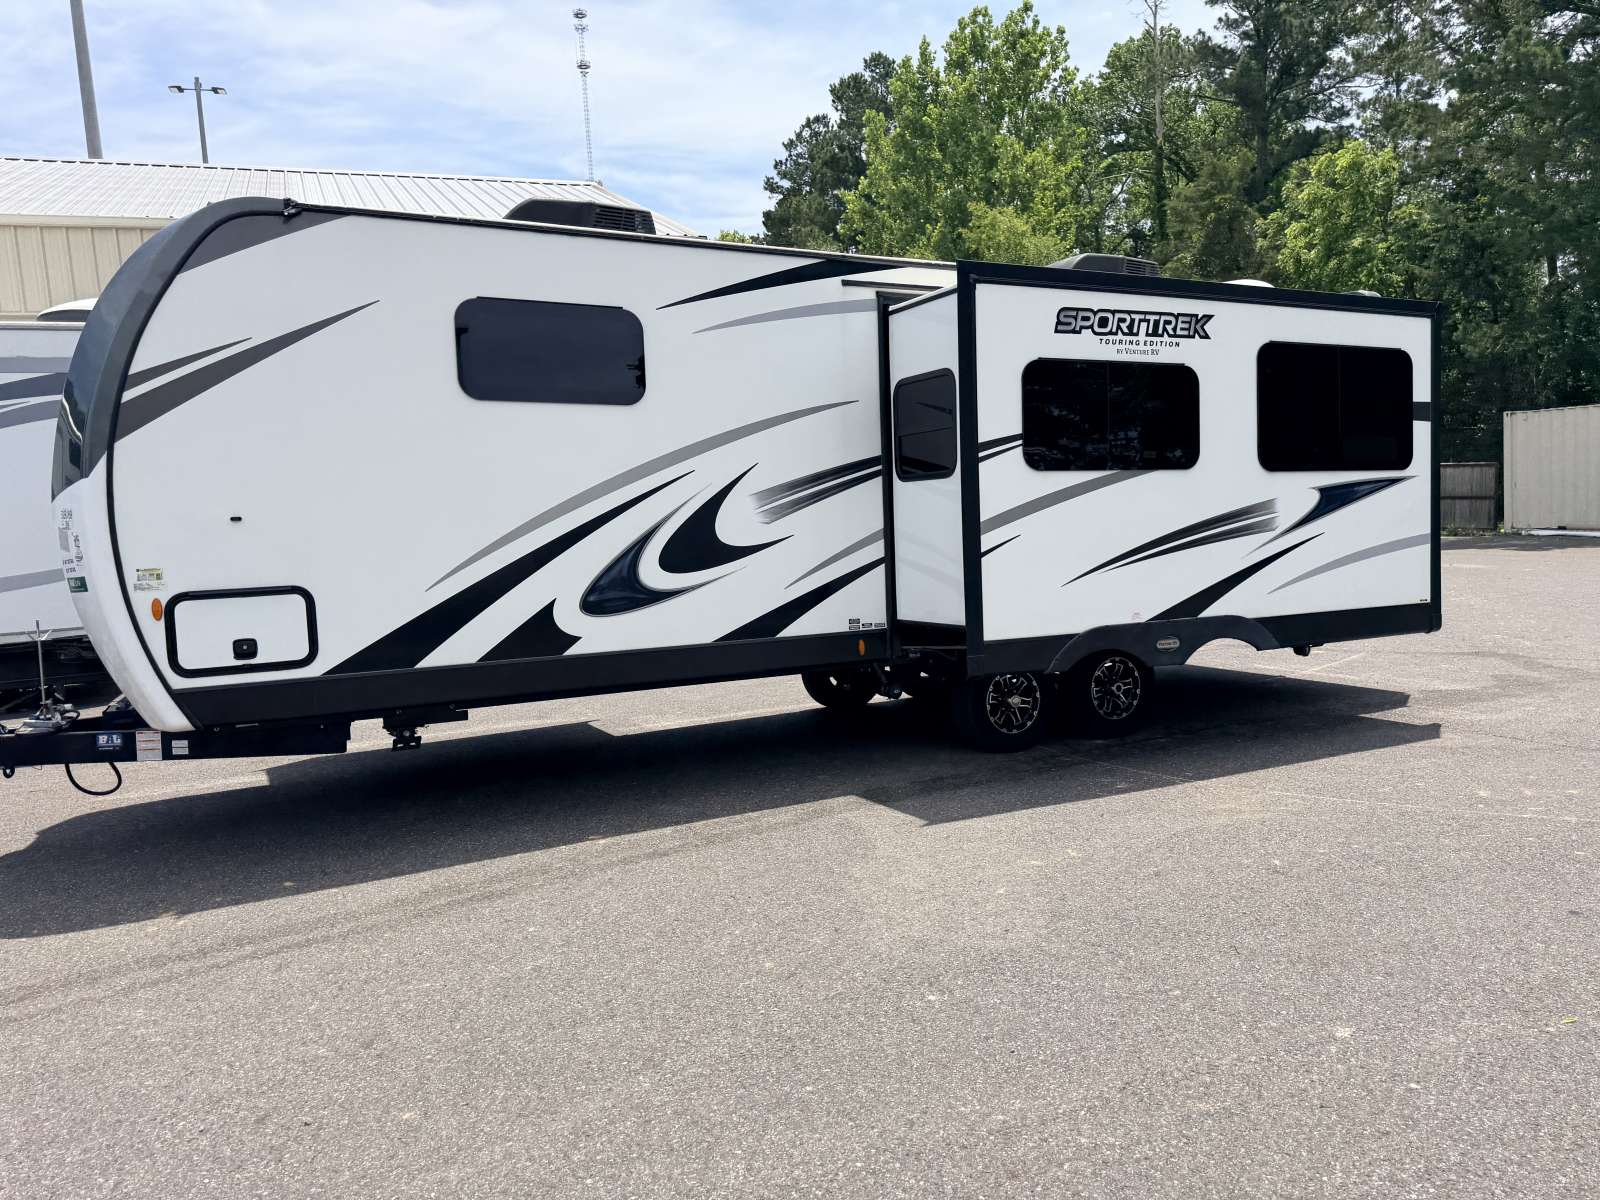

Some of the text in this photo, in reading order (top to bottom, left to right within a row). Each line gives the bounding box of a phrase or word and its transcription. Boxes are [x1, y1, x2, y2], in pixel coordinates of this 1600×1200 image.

[1054, 307, 1216, 340] SPORTTREK
[1099, 338, 1181, 348] TOURING EDITION
